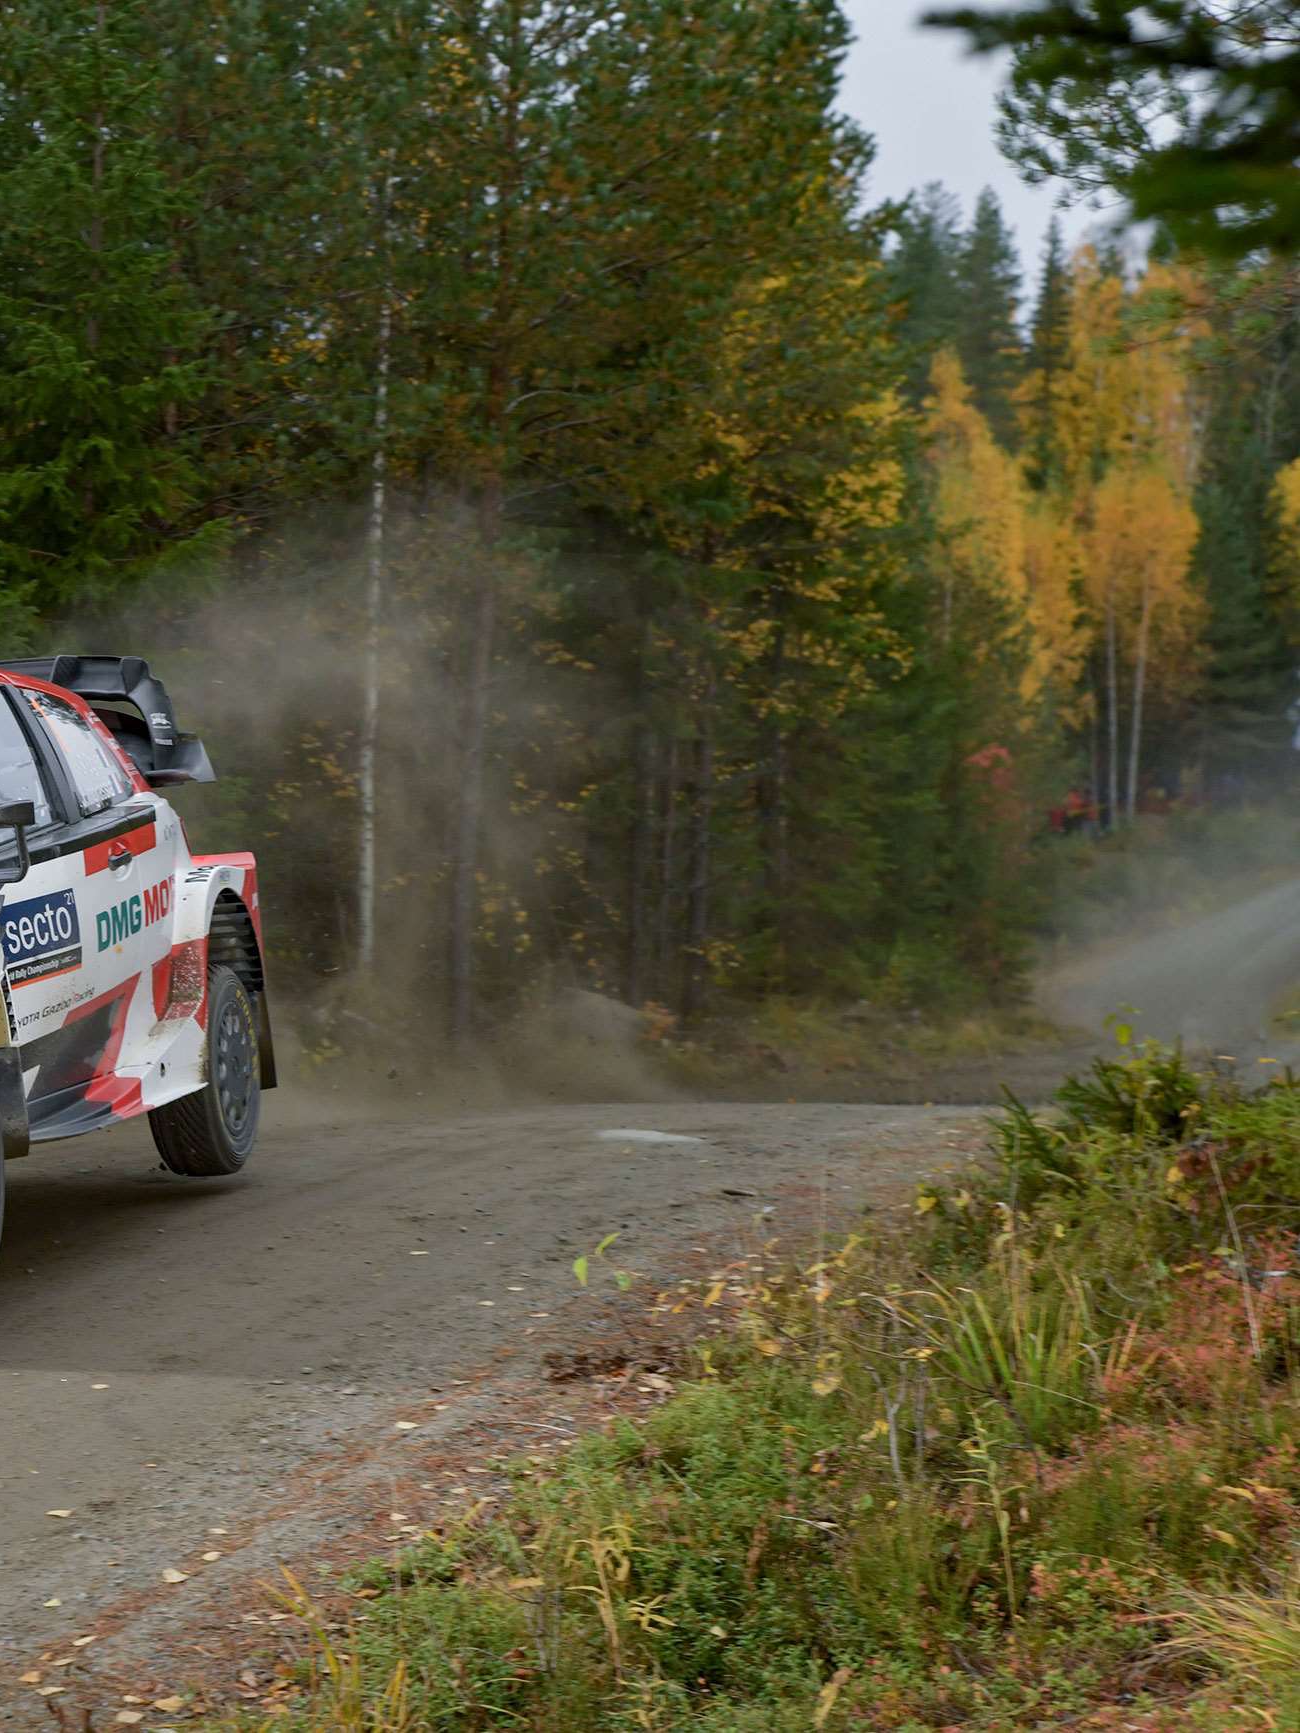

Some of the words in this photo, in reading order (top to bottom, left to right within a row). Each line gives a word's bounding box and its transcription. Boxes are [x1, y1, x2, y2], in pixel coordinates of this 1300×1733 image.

[5, 903, 72, 954] secto
[96, 894, 142, 952] DMG
[16, 1011, 40, 1029] YOTA
